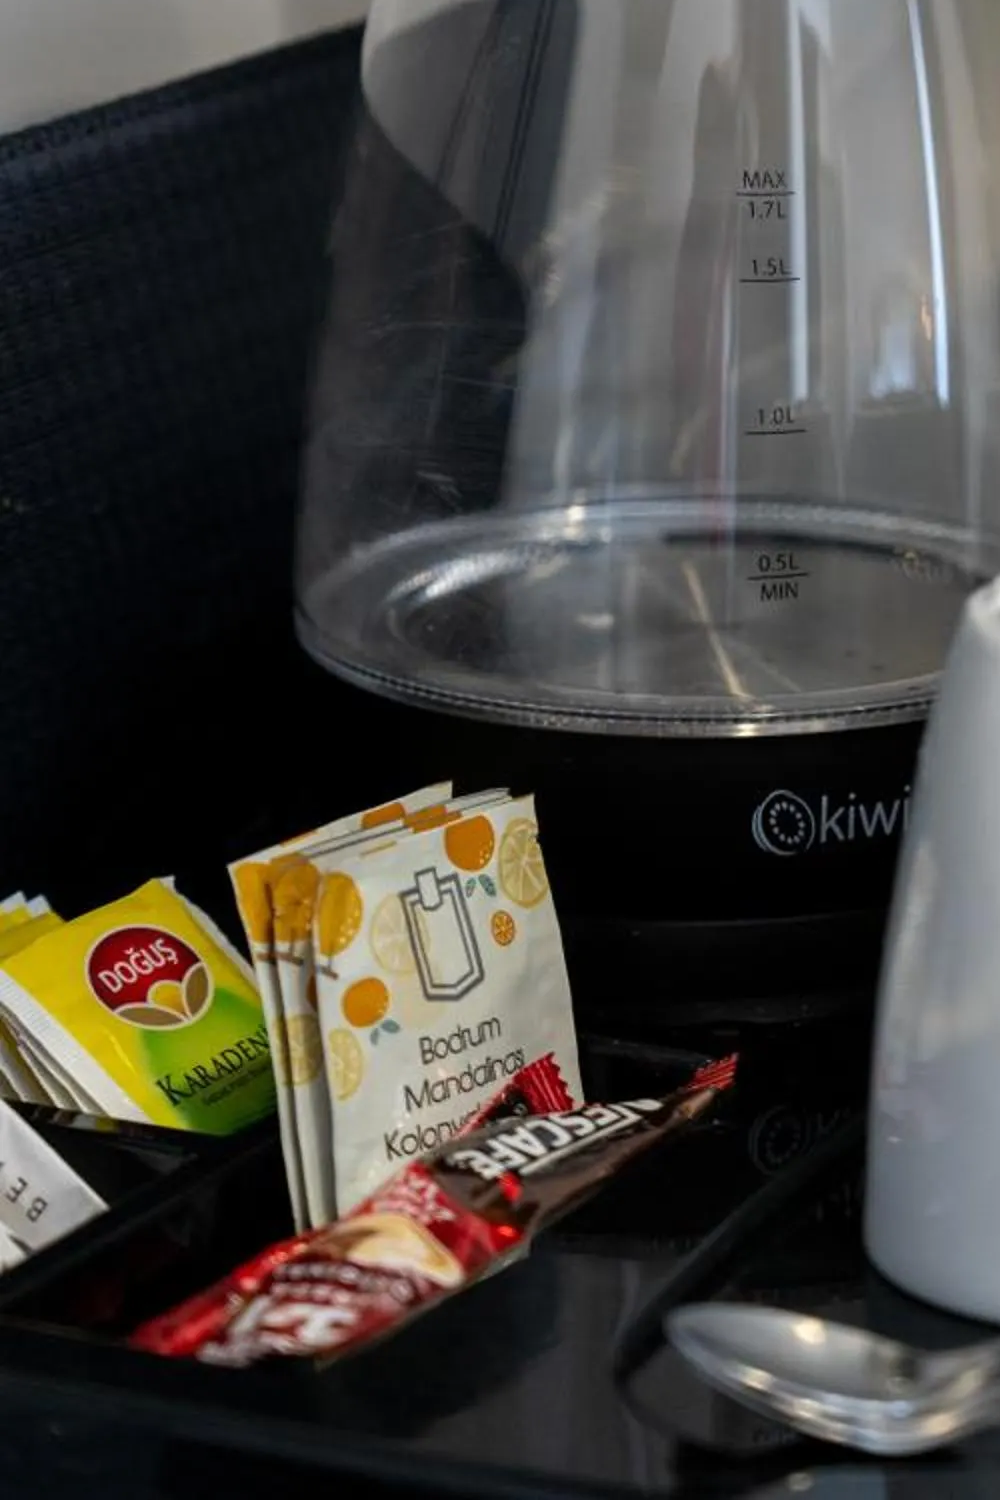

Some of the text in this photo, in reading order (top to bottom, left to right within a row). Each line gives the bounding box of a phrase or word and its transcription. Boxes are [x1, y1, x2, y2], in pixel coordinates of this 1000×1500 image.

[743, 169, 787, 189] MAX
[749, 200, 788, 220] 1.7L
[751, 257, 791, 277] 1.5L
[757, 406, 795, 426] 1.0L
[758, 552, 800, 573] 0.5L
[760, 581, 799, 602] MIN
[820, 784, 911, 843] kiwi
[97, 937, 179, 994] DOĞUŞ
[418, 1016, 502, 1065] Bodrum
